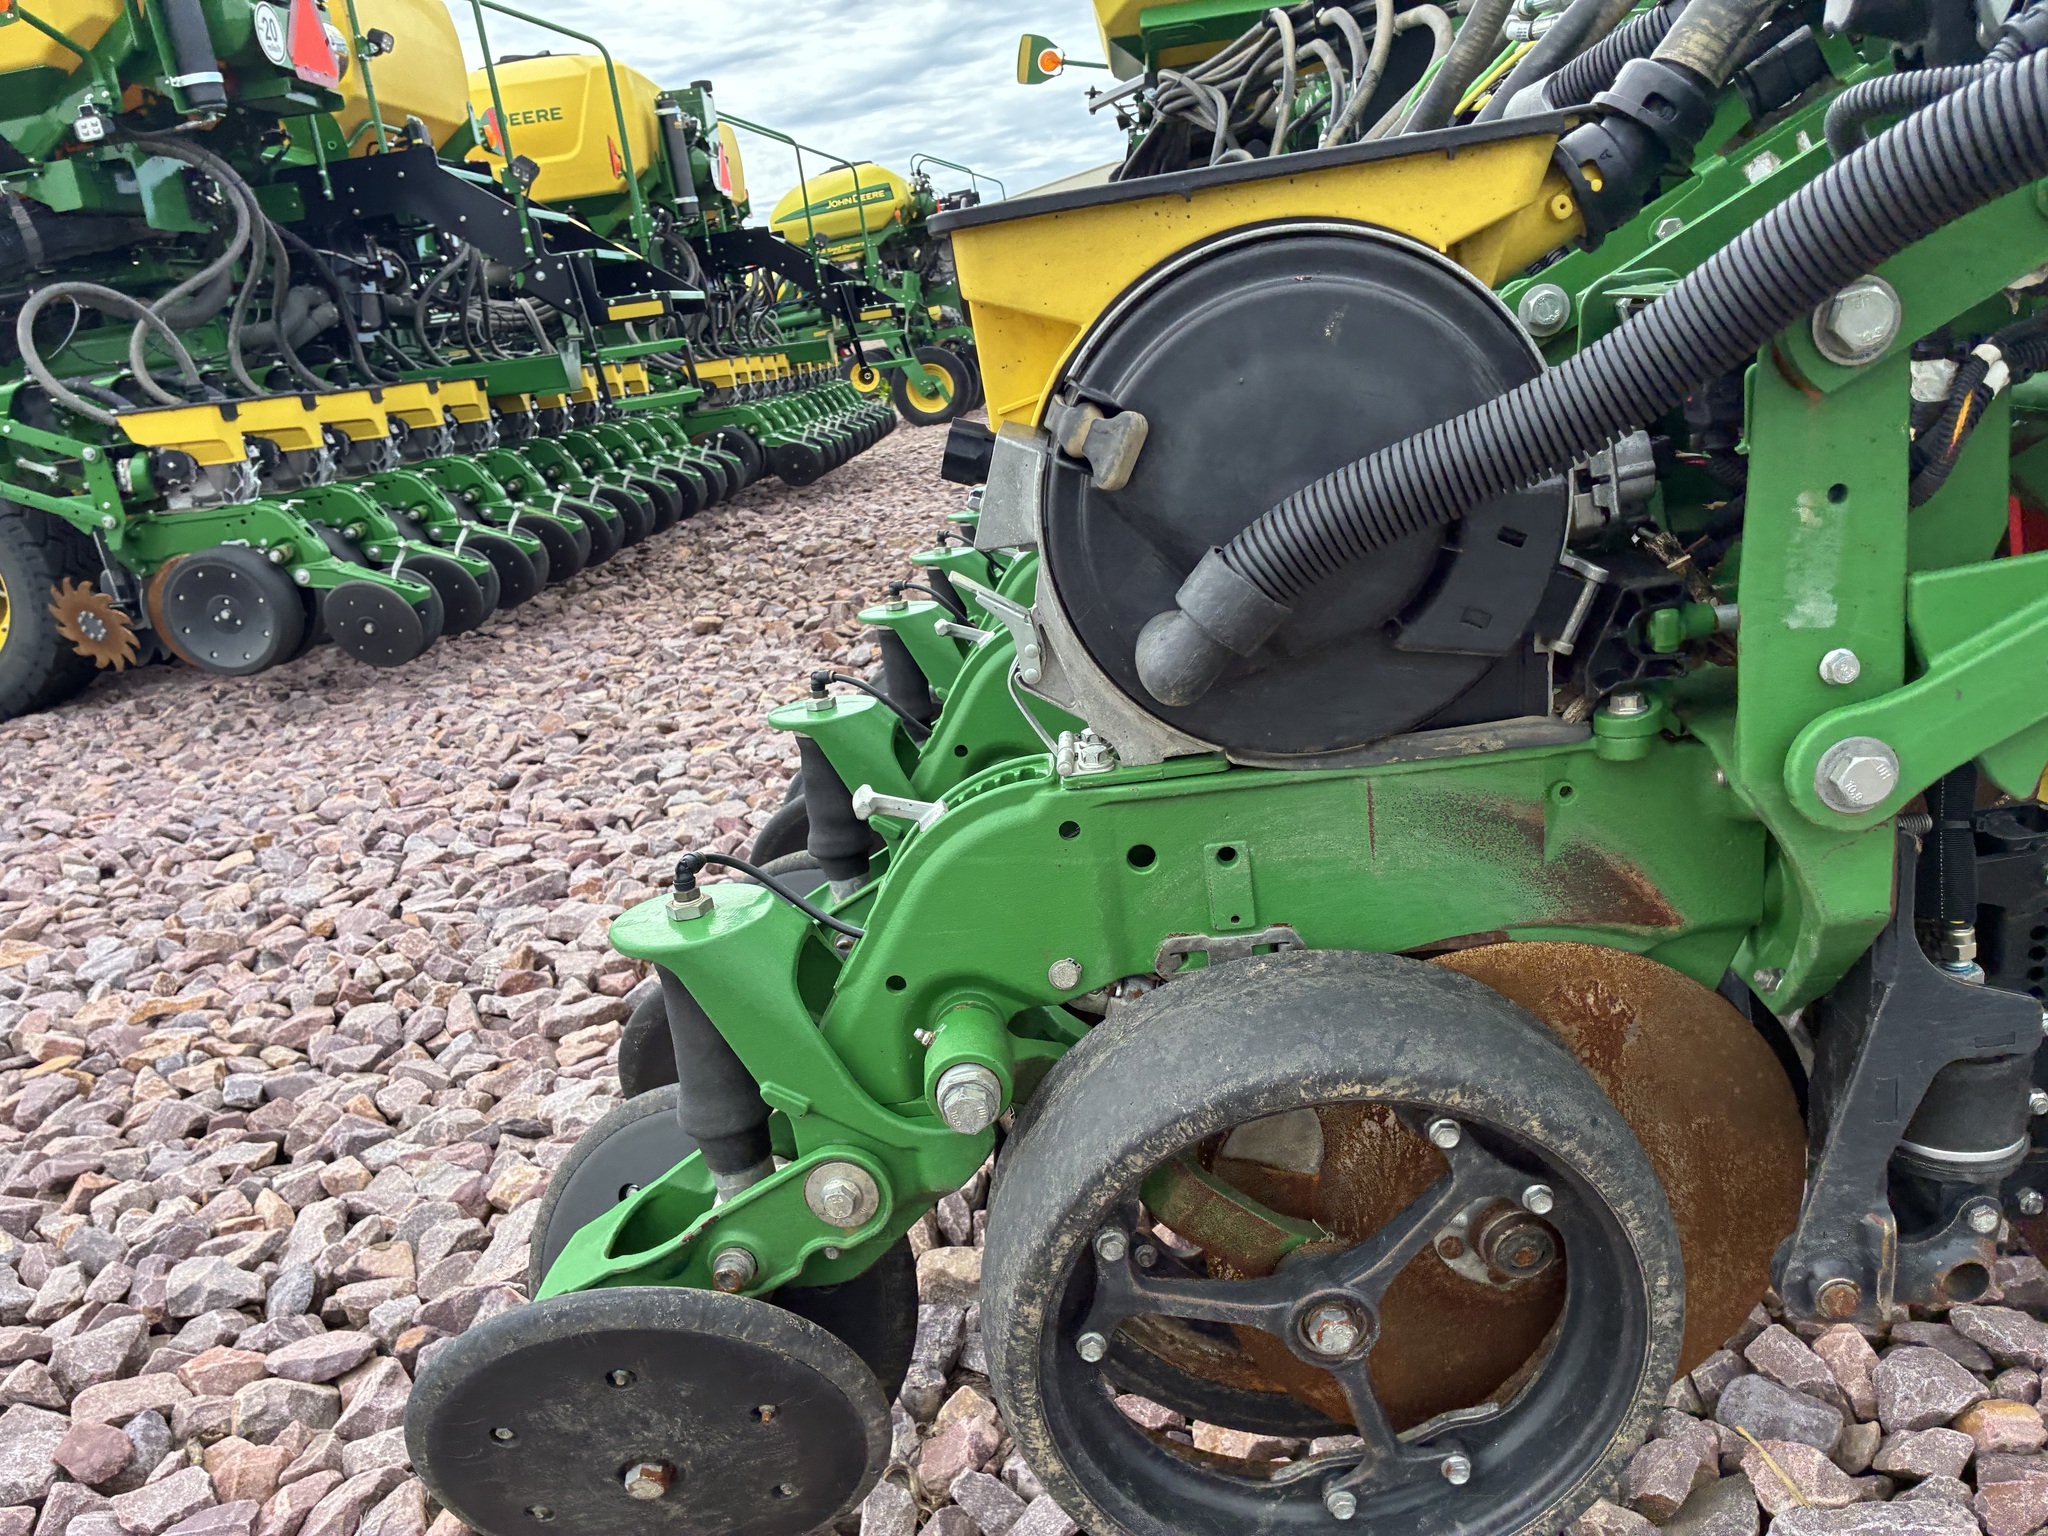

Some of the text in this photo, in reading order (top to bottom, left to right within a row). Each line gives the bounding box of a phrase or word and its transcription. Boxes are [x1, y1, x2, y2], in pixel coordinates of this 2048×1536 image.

[260, 16, 278, 43] 20
[503, 106, 563, 127] EERE
[827, 195, 852, 210] JOHN
